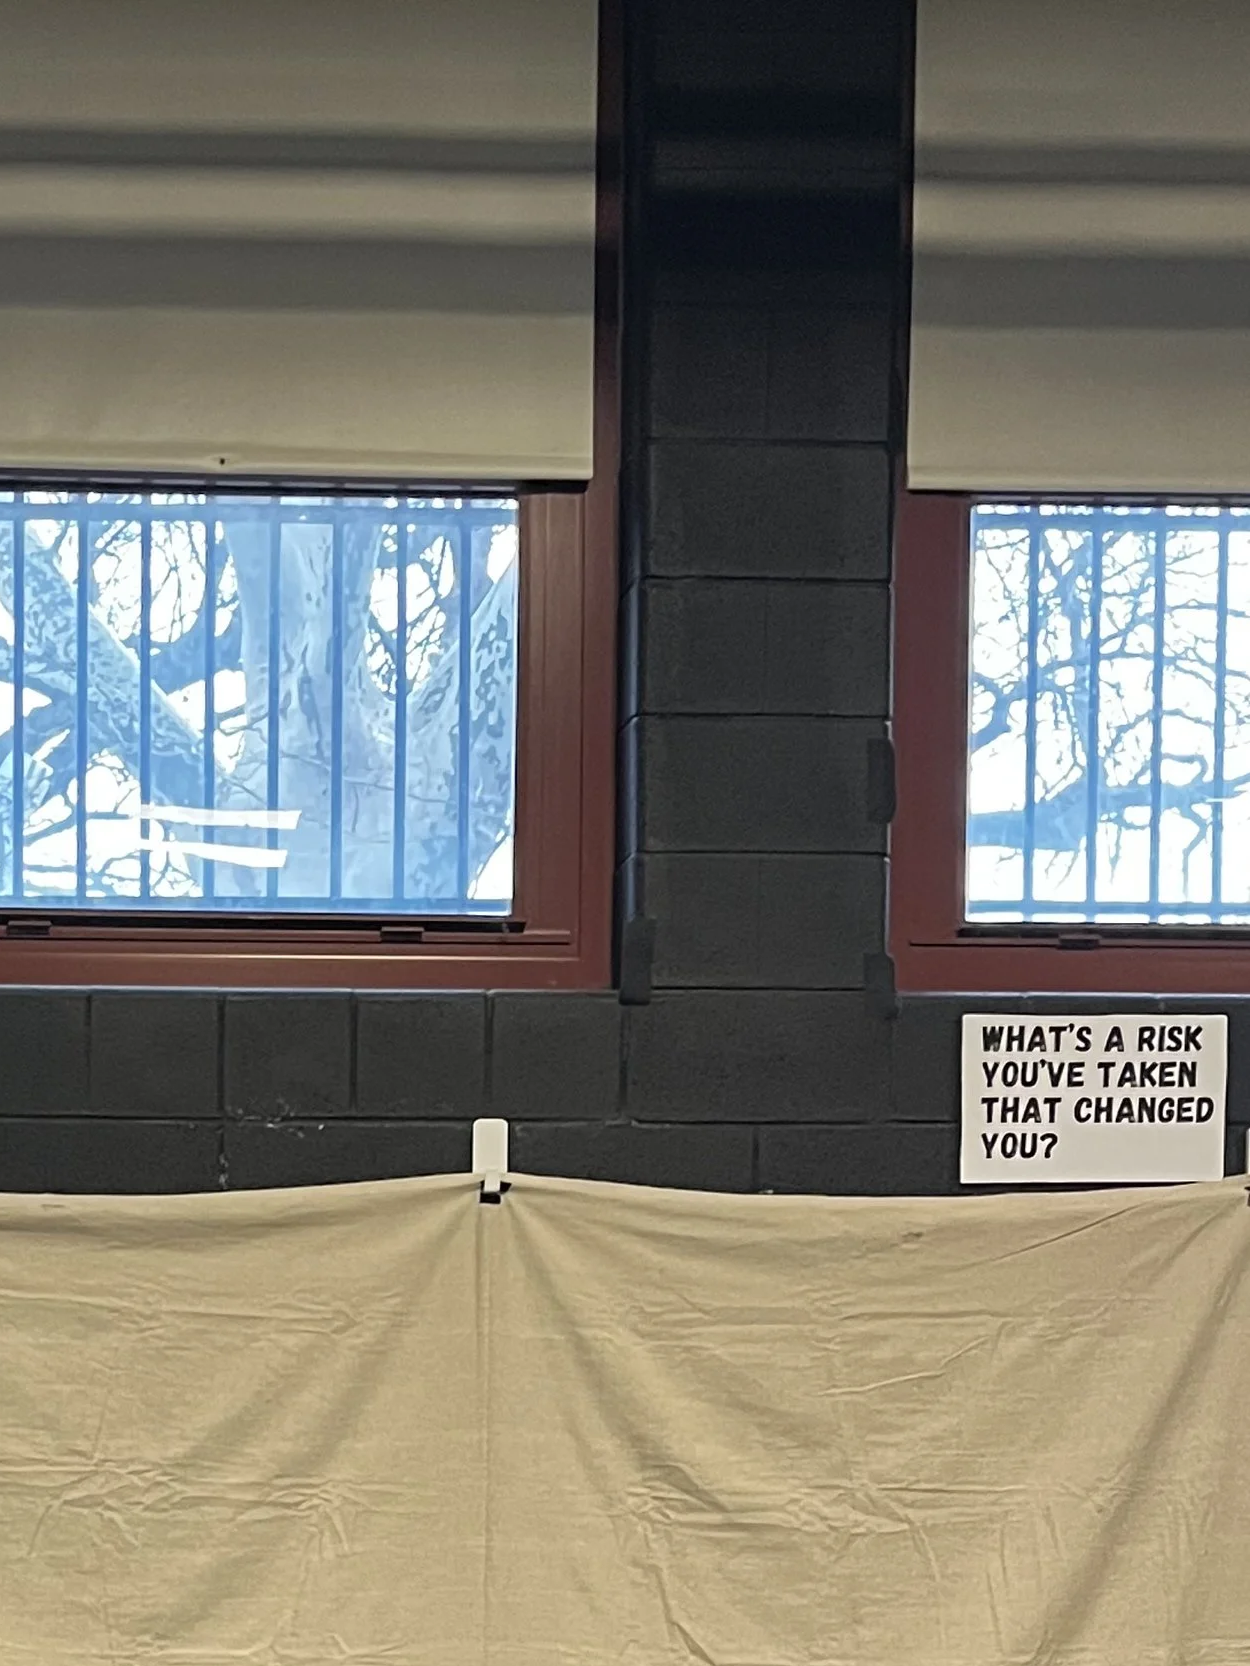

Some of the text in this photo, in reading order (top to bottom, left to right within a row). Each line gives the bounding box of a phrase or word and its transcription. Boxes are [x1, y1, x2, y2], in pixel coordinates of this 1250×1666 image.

[983, 1023, 1202, 1052] WHAT'S A RISK
[983, 1059, 1196, 1087] YOU'VE TAKEN
[982, 1097, 1213, 1123] THAT CHANGED
[982, 1133, 1057, 1158] YOU?
